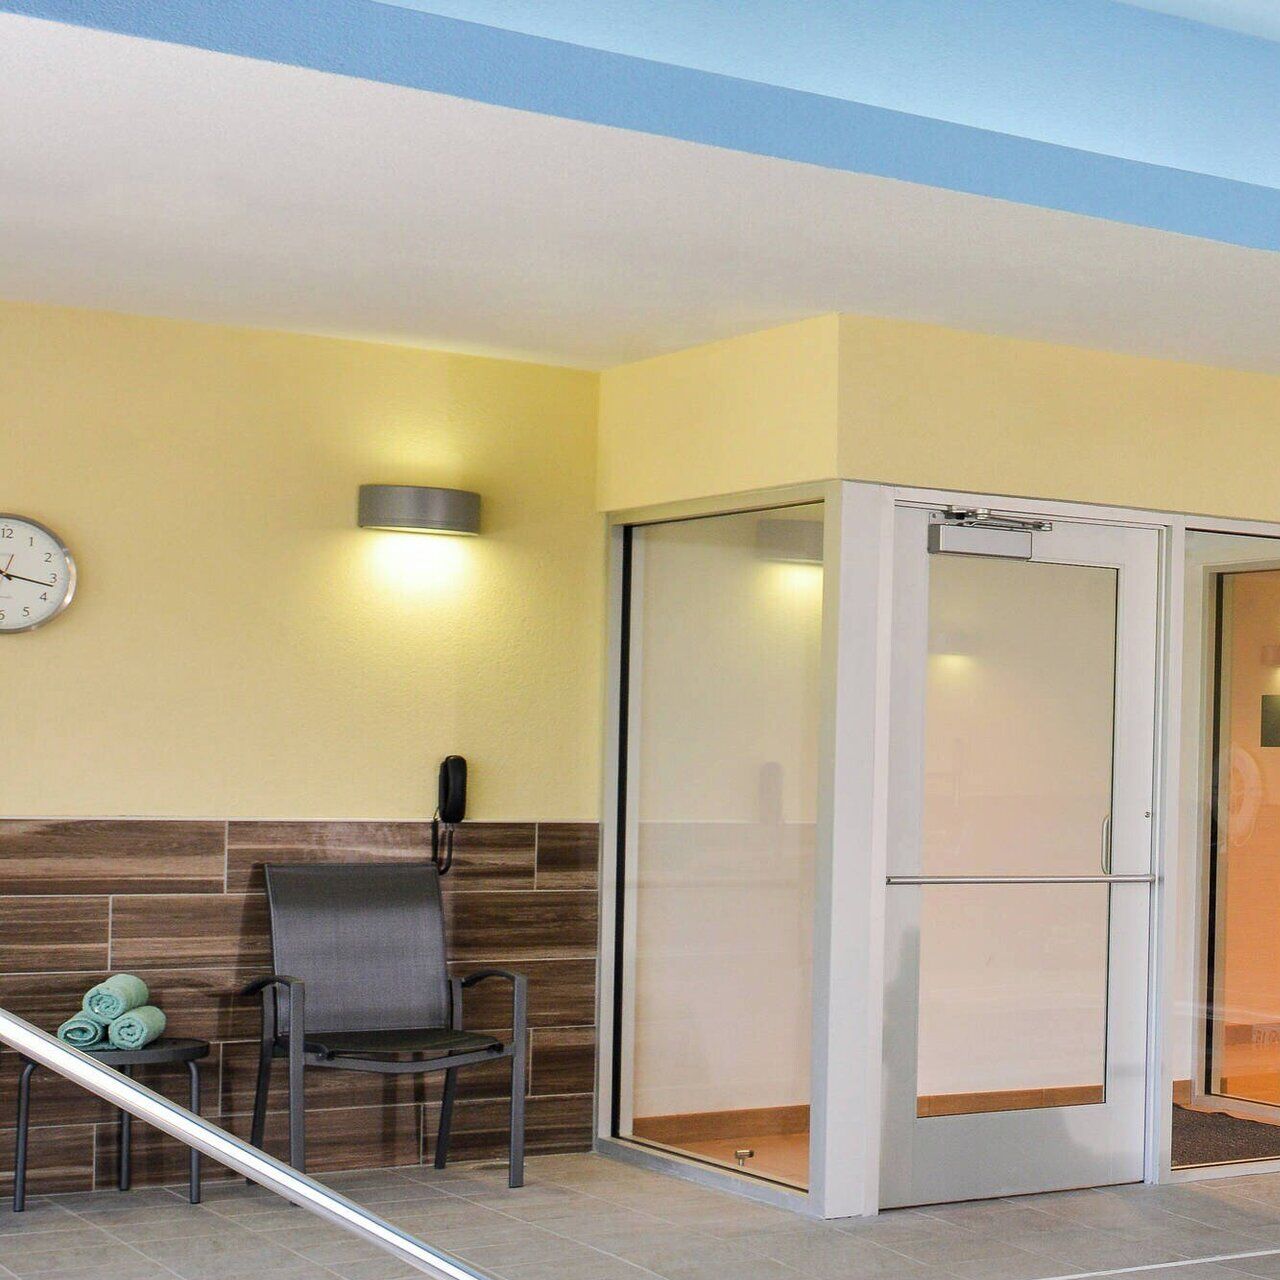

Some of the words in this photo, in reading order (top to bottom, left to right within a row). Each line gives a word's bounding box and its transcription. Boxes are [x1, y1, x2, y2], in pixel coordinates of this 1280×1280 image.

[1, 528, 14, 539] 12
[29, 536, 34, 547] 1
[44, 552, 52, 563] 2
[50, 573, 57, 583] 3
[40, 592, 47, 602] 4
[22, 606, 30, 617] 5
